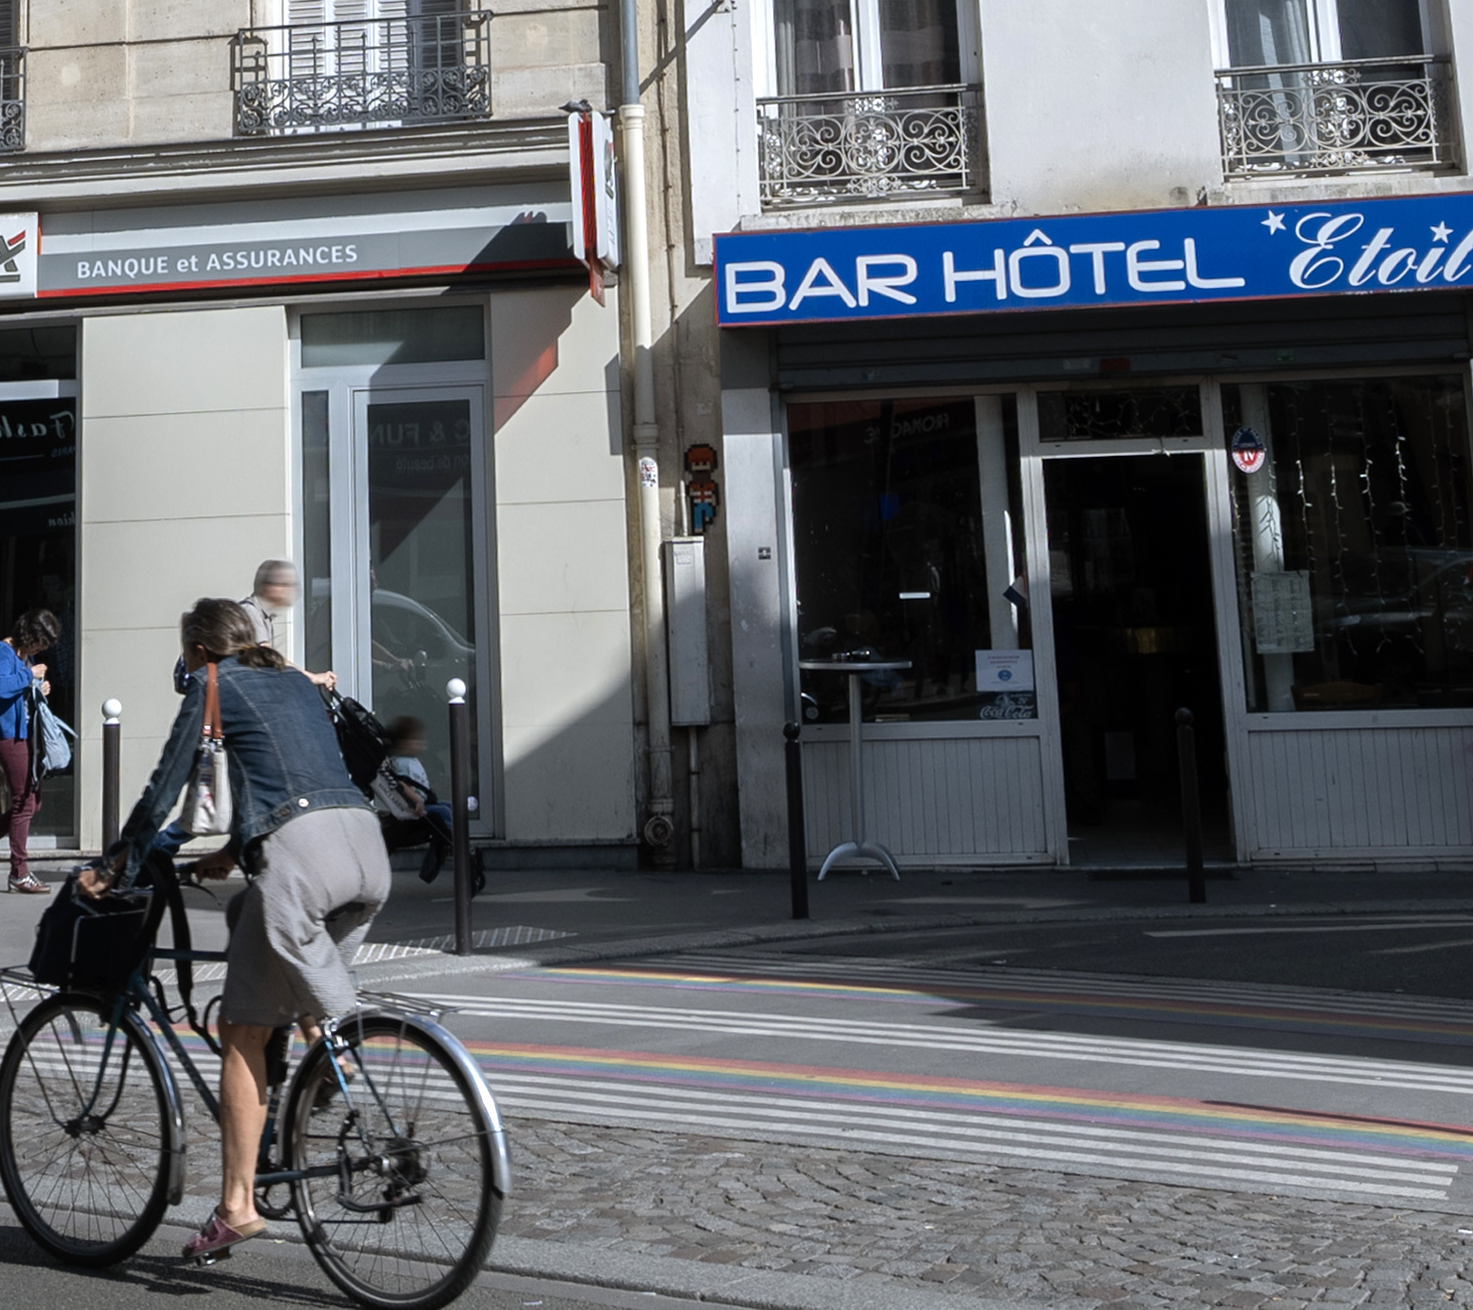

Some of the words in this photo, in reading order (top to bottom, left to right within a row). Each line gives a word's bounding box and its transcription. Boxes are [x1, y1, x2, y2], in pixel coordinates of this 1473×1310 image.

[77, 256, 169, 279] BANQUE
[177, 255, 198, 273] et
[207, 244, 359, 272] ASSURANCES
[724, 252, 919, 314] BAR
[943, 231, 1247, 303] HÔTEL
